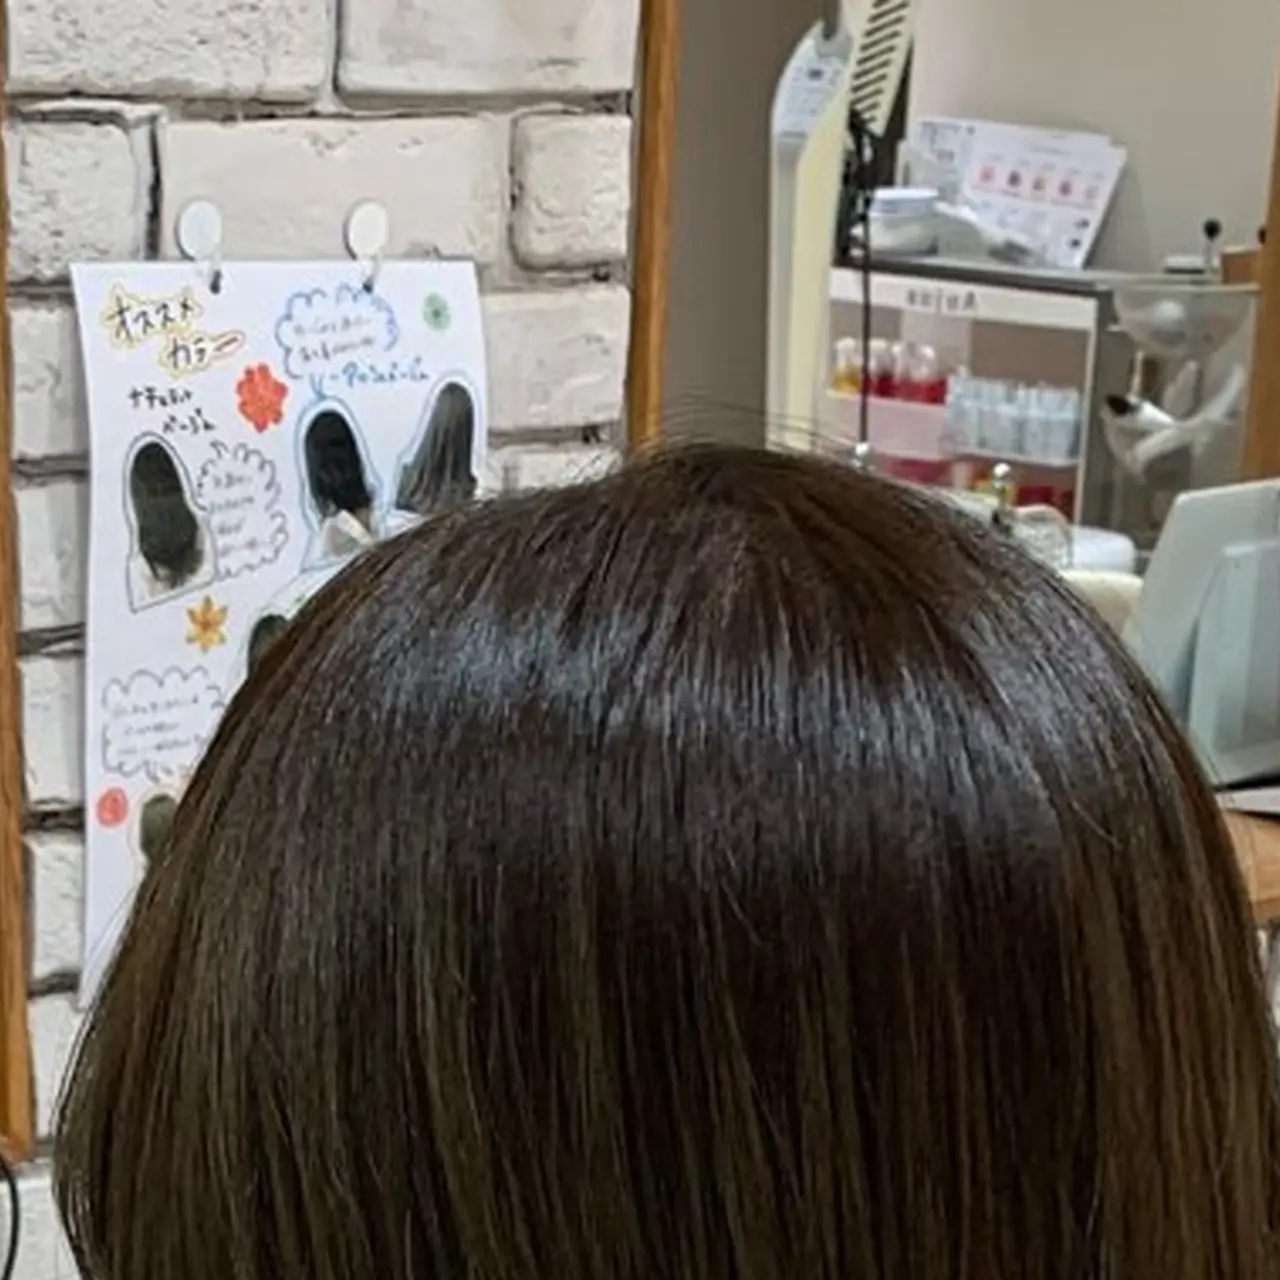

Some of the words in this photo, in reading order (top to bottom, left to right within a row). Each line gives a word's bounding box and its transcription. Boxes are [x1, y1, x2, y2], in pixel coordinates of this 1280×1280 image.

[105, 294, 194, 344] オススメ
[167, 335, 239, 370] カラー
